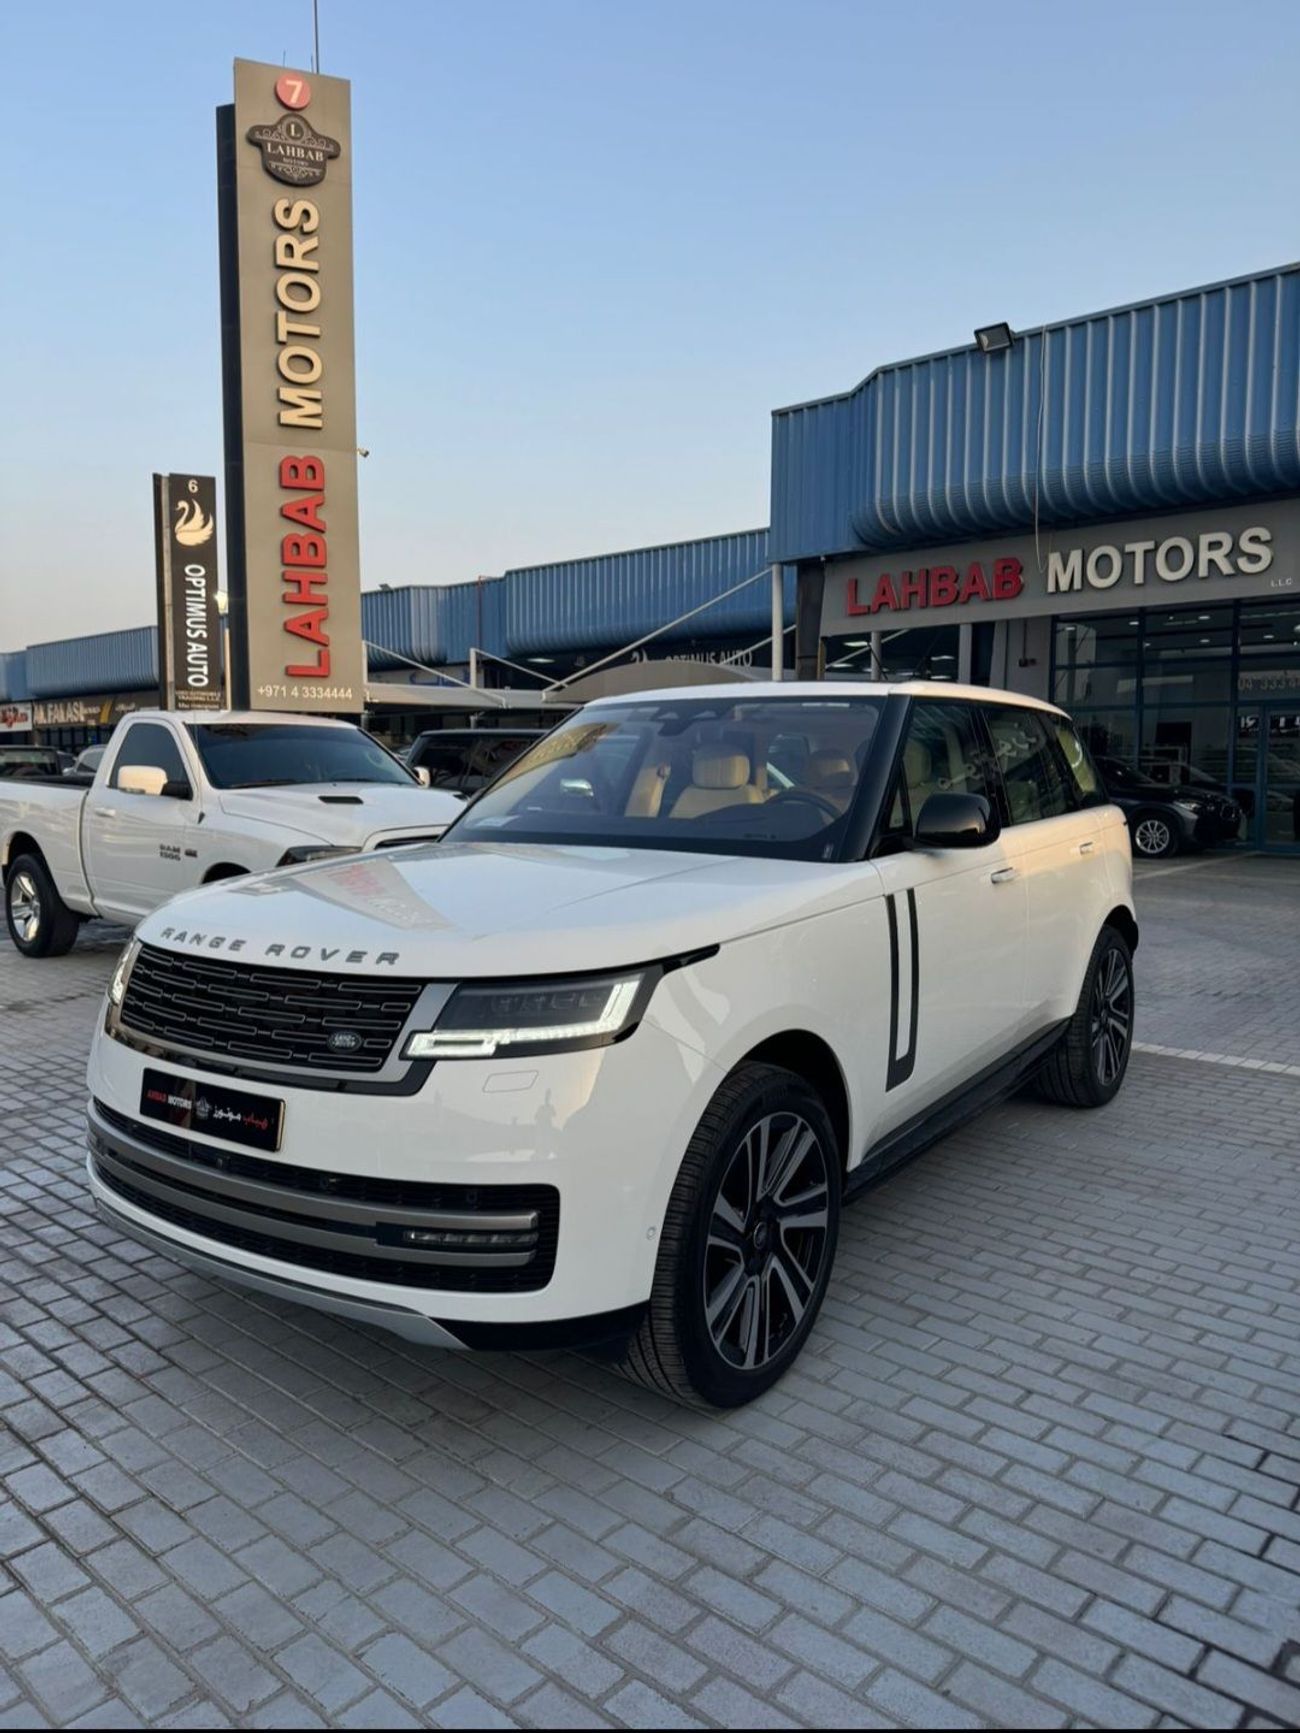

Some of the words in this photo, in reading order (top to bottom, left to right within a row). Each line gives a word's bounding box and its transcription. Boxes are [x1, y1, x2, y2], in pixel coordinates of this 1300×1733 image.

[285, 79, 302, 104] 7
[290, 123, 300, 137] L
[266, 142, 325, 162] LAHBAB
[274, 198, 323, 429] MOTORS
[188, 479, 199, 493] 6
[280, 455, 330, 677] LAHBAB
[846, 556, 1024, 617] LAHBAB
[1046, 526, 1274, 595] MOTORS
[184, 563, 207, 639] OPTIMUS
[187, 641, 209, 687] AUTO
[257, 685, 286, 698] +971
[291, 687, 299, 698] 4
[302, 687, 353, 701] 3334444
[159, 844, 181, 855] RAM
[160, 926, 248, 951] RANGE
[264, 943, 401, 966] ROVER
